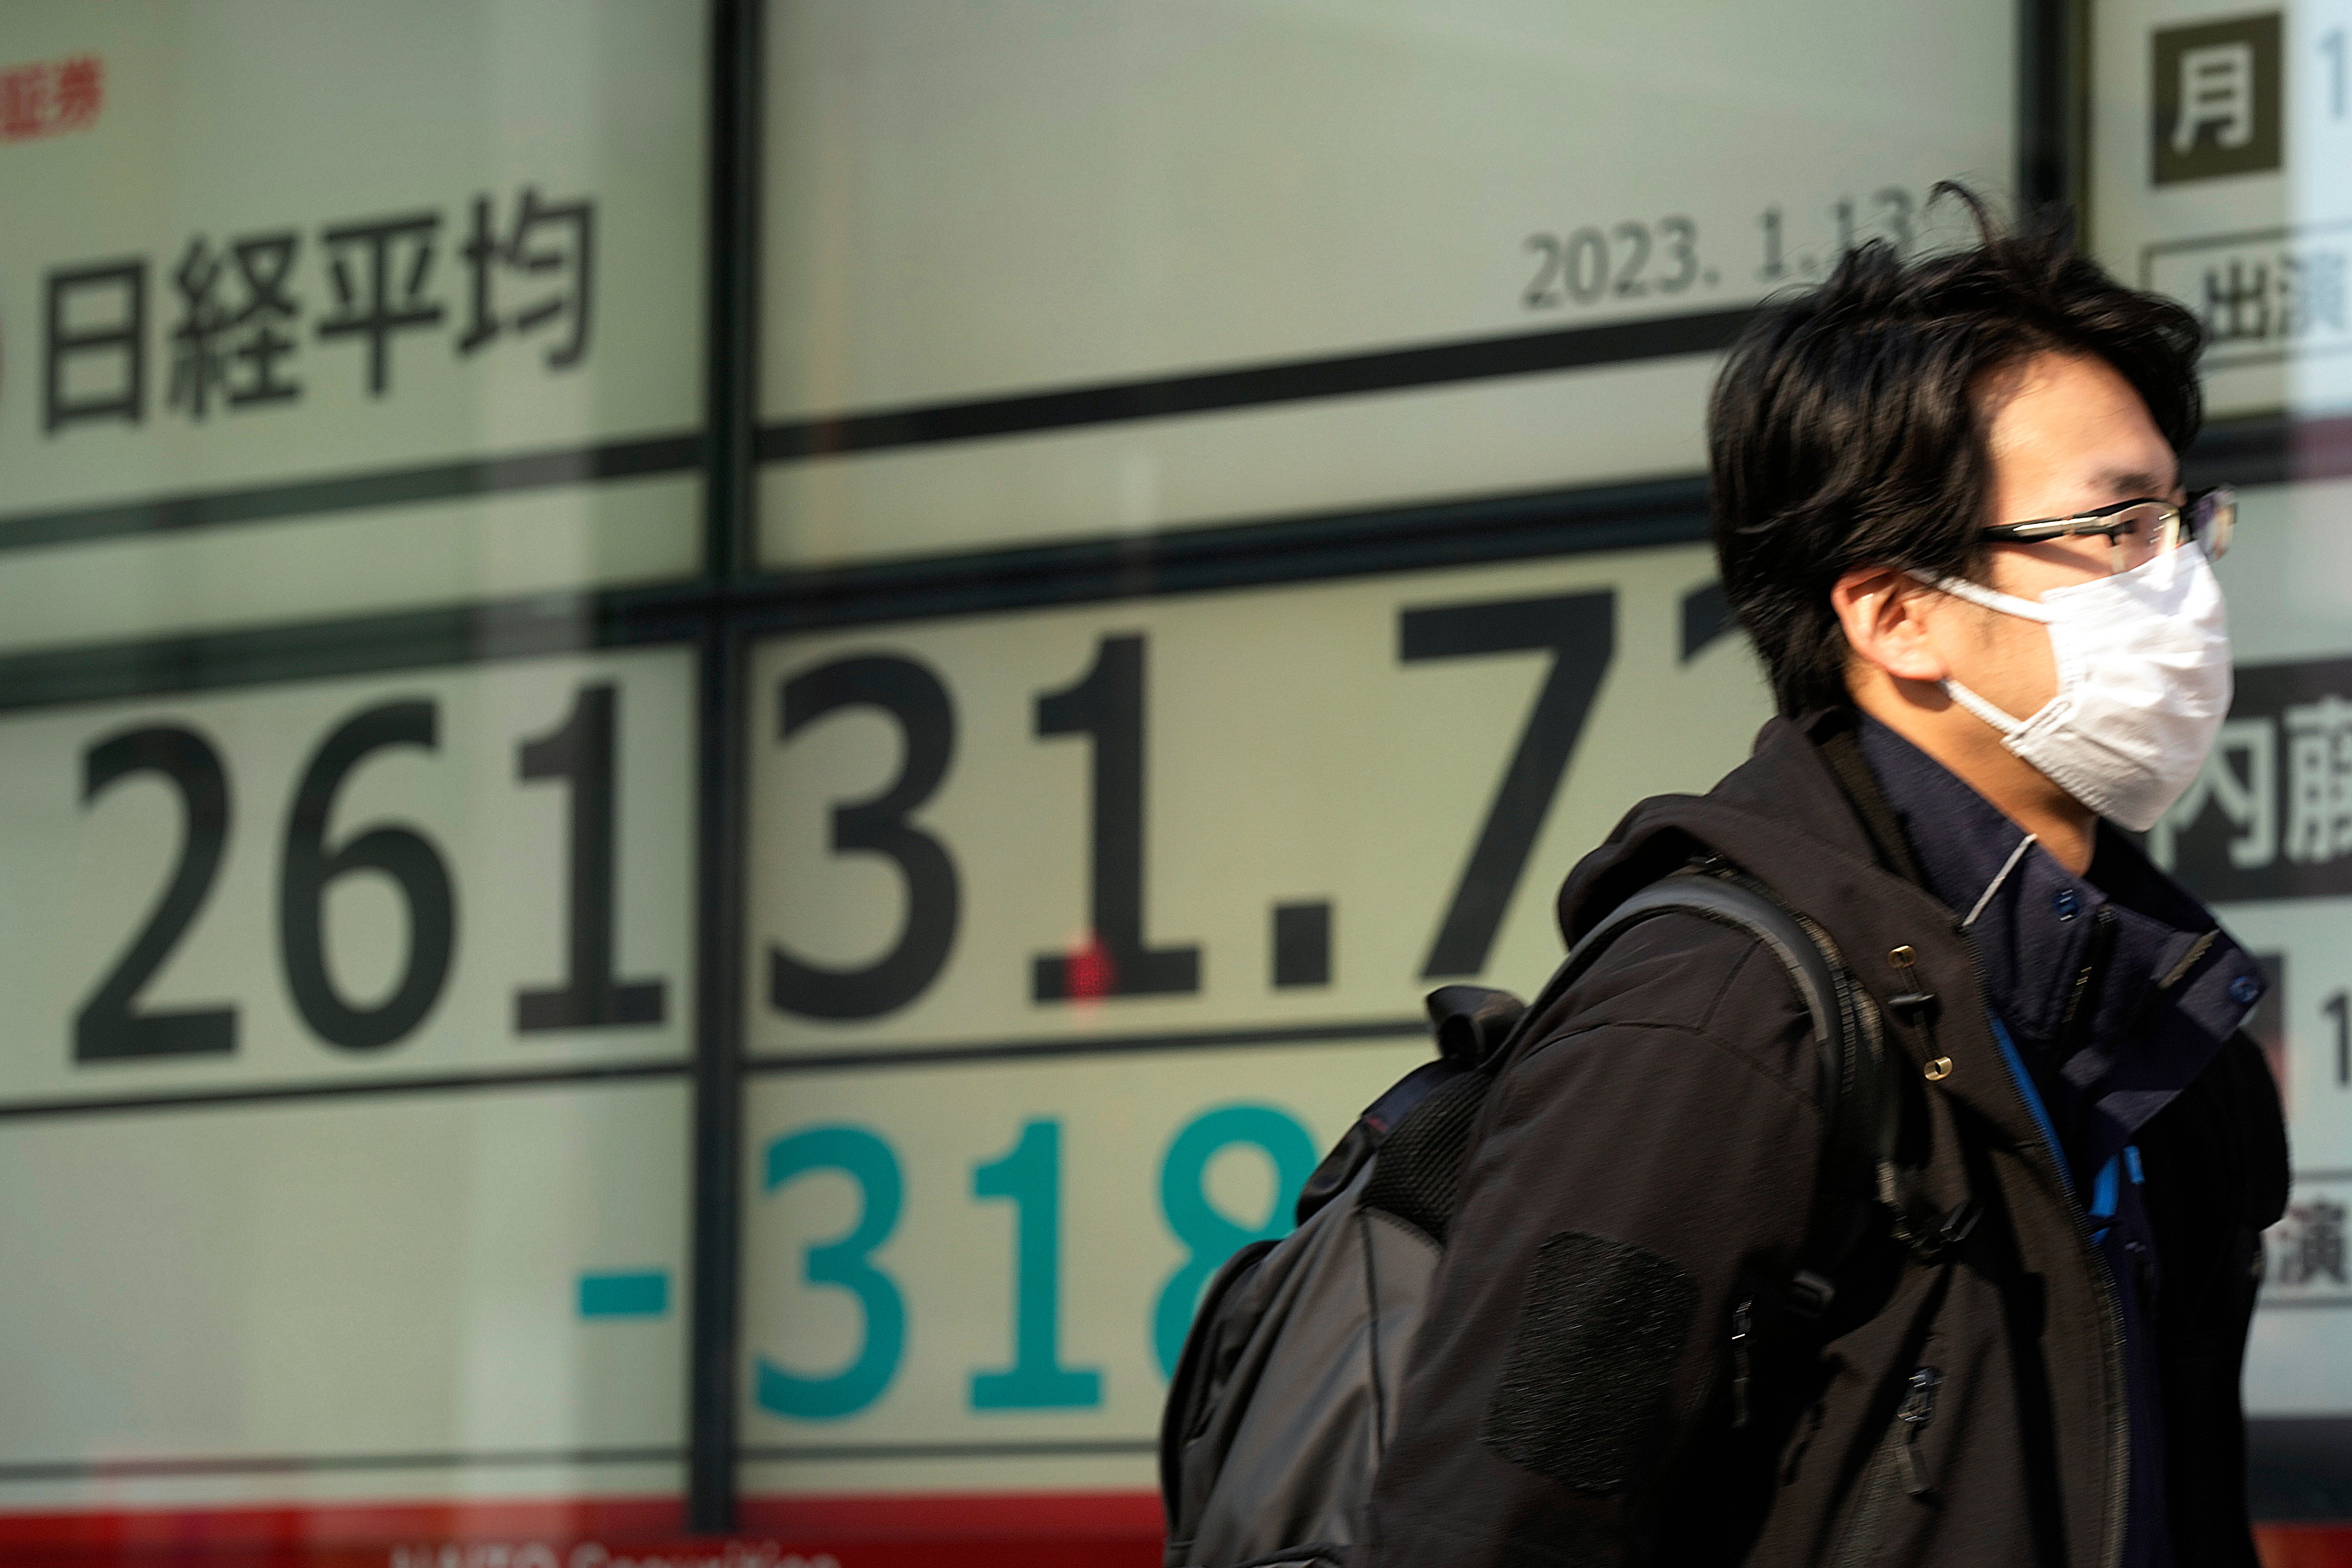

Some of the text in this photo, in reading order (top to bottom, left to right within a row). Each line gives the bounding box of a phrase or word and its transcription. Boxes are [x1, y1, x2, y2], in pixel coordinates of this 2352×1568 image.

[2173, 41, 2254, 154] 月
[41, 183, 599, 436] 日経平均
[1521, 214, 1723, 309] 2023.
